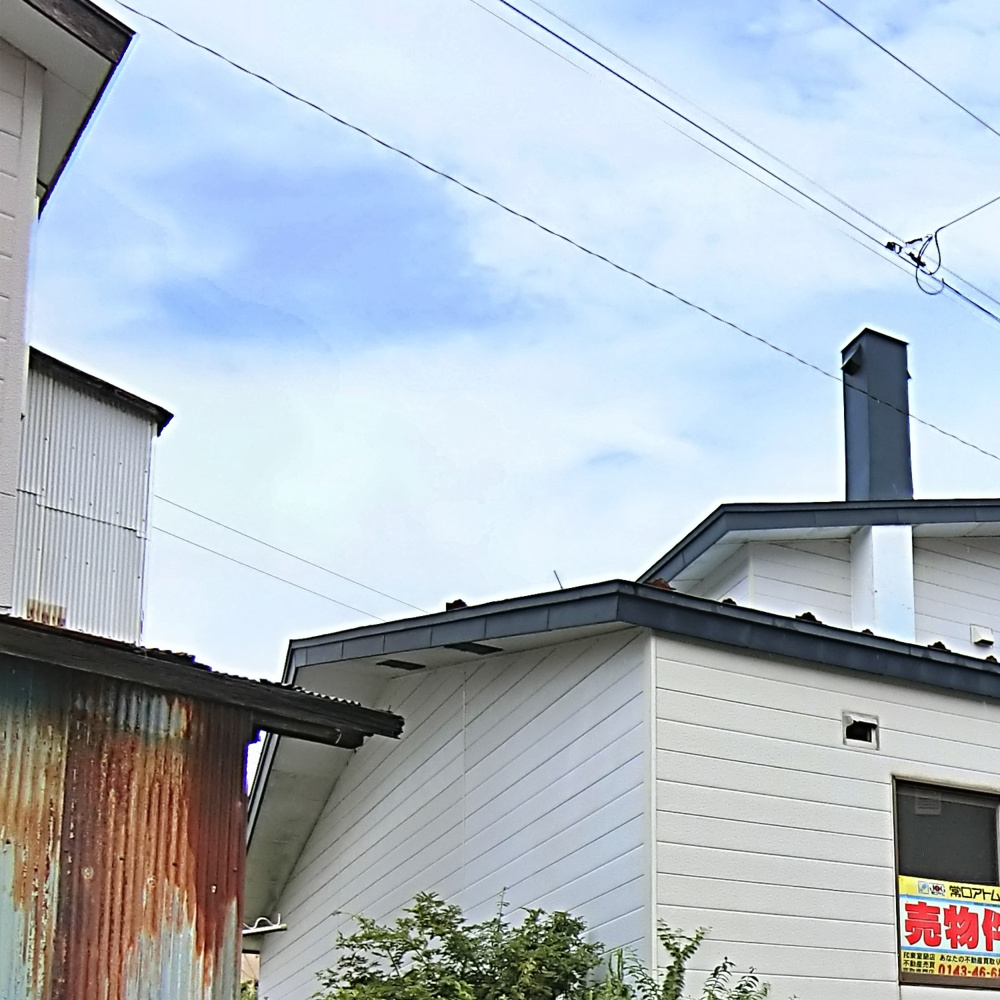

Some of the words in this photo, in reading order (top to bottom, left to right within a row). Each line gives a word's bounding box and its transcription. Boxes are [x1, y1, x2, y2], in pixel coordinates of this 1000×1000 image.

[949, 885, 1000, 902] 常口アトム
